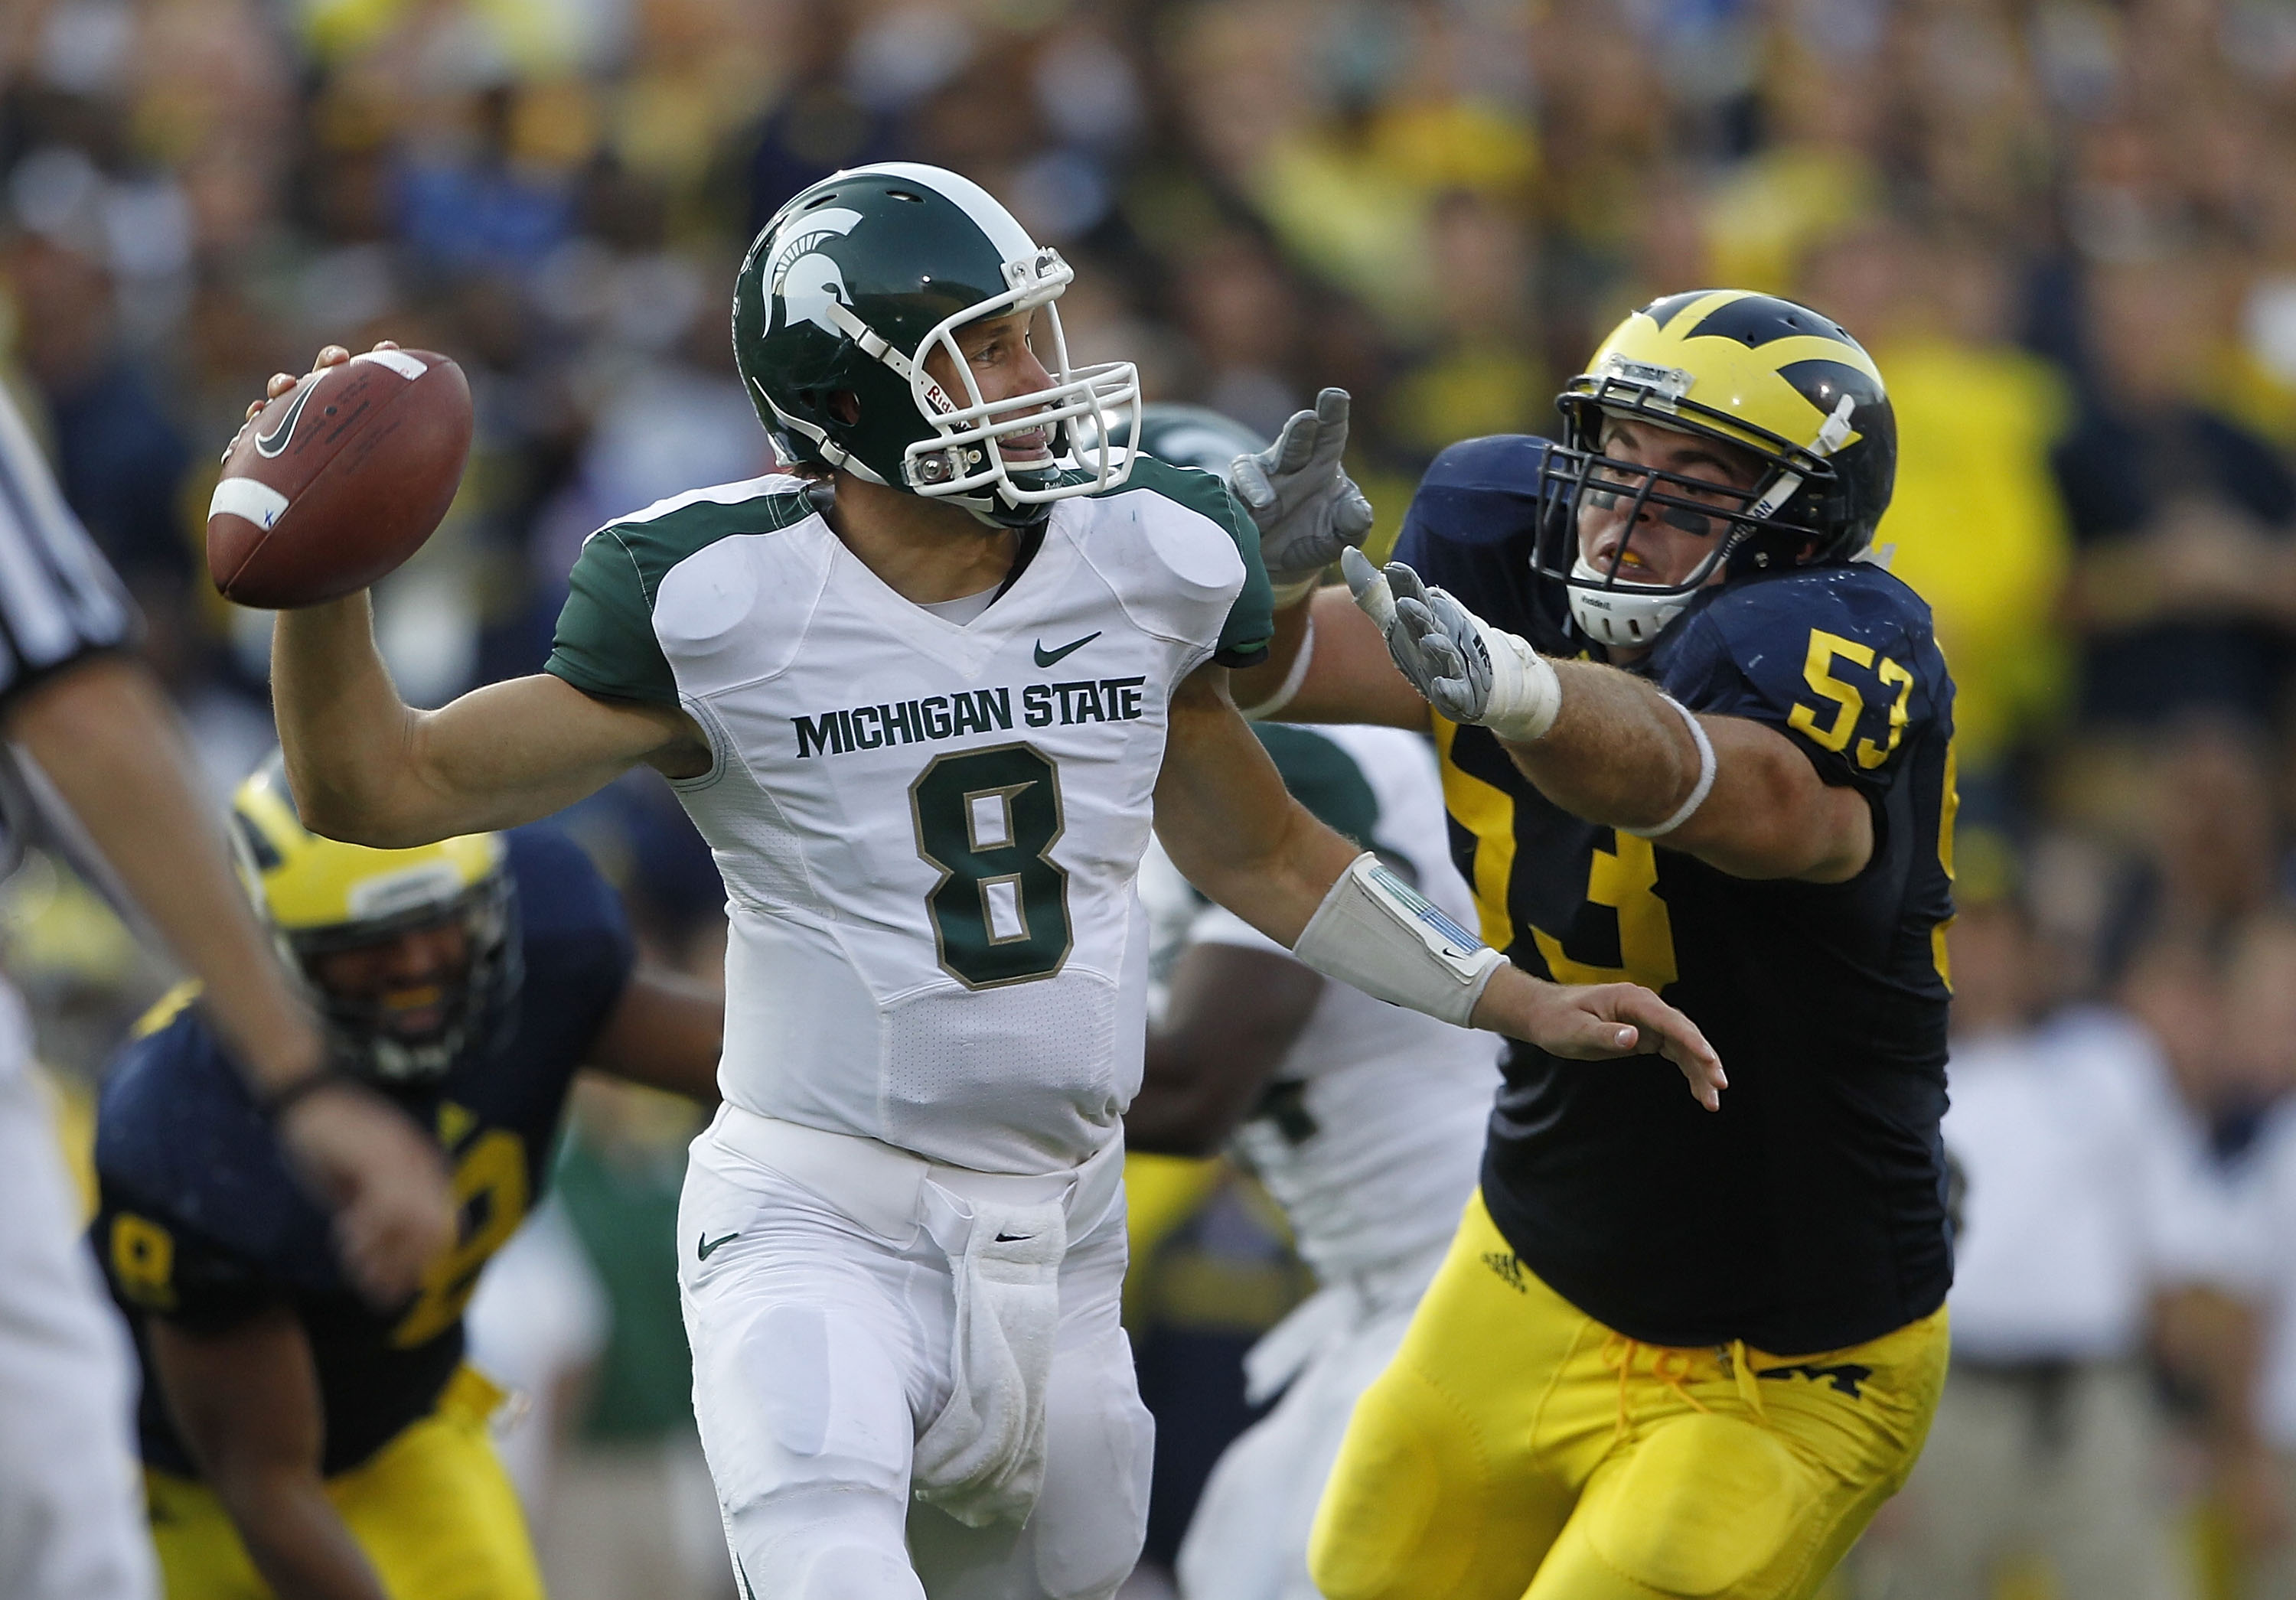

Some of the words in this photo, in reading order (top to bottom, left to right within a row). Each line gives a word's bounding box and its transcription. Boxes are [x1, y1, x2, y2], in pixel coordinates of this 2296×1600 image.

[790, 687, 1014, 758] MICHIGAN
[1024, 676, 1146, 728] STATE
[1788, 627, 1913, 770] 53
[908, 740, 1074, 991] 8
